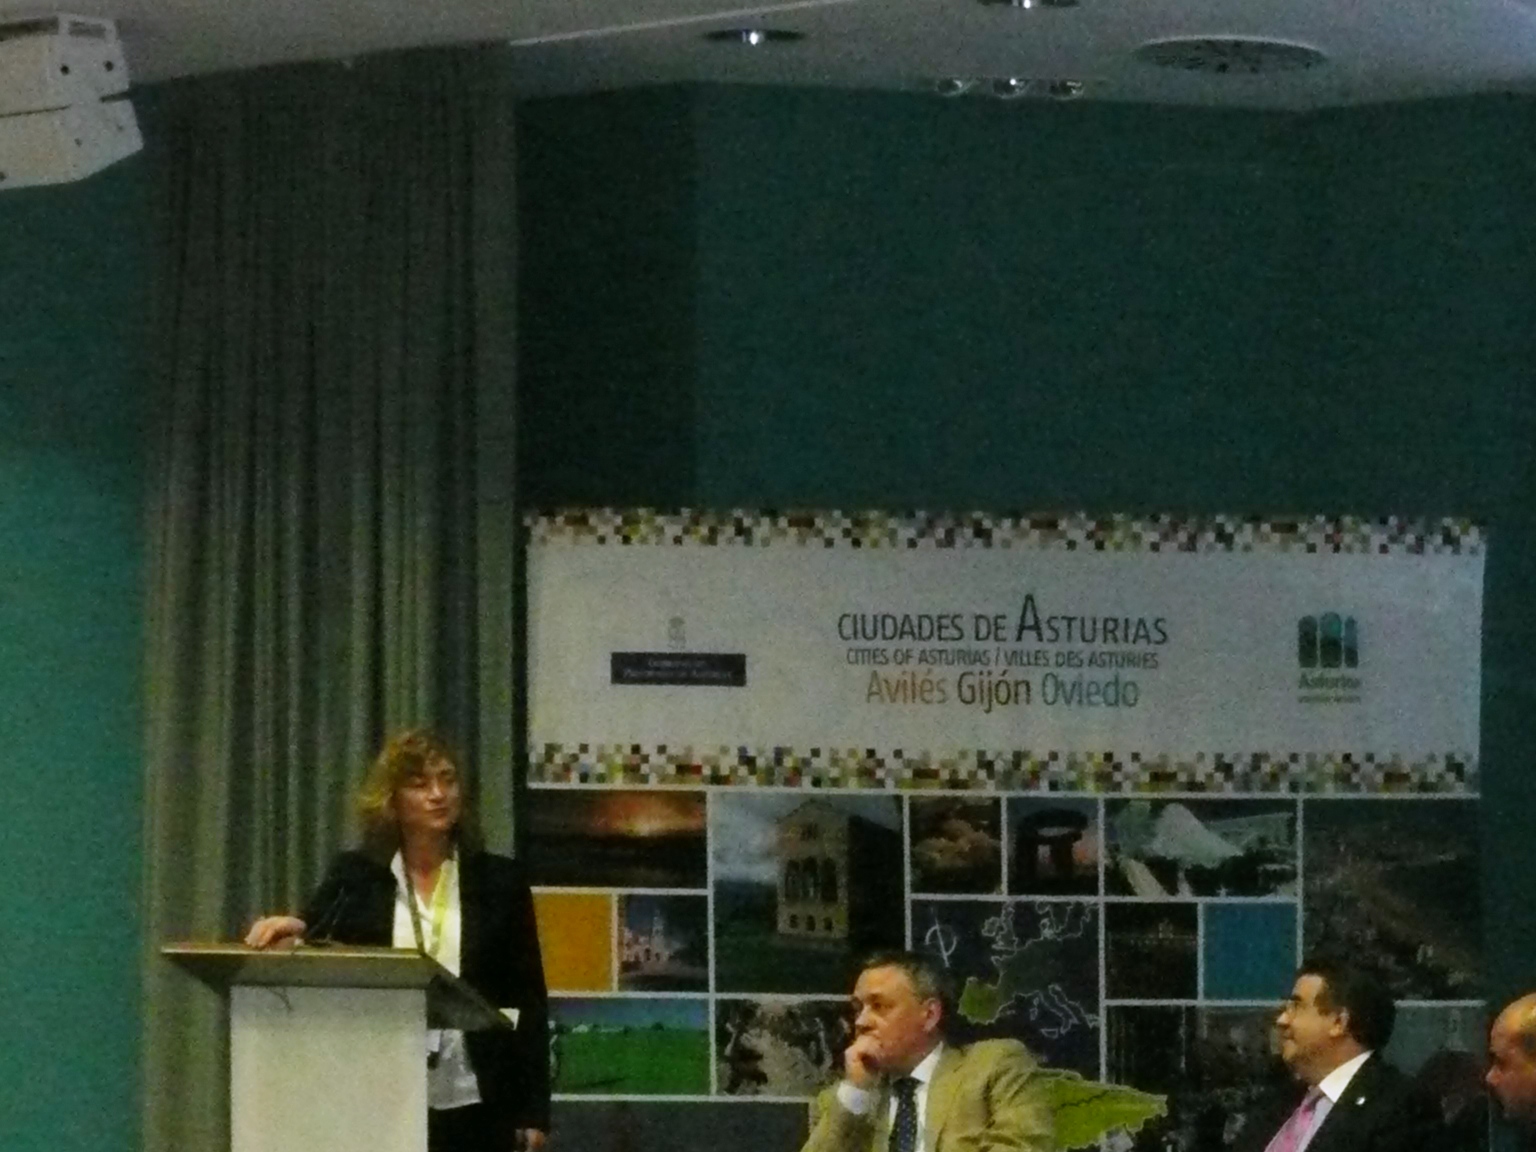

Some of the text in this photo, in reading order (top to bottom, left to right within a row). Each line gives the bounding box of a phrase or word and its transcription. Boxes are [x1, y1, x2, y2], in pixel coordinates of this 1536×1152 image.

[838, 613, 965, 642] CIUDADES
[974, 613, 1007, 642] DE
[847, 647, 889, 666] CITIES
[893, 648, 914, 666] OF
[918, 648, 991, 667] ASTURIAS
[1004, 649, 1050, 668] VILLES
[1055, 650, 1084, 669] DES
[1088, 651, 1160, 670] ASTURIES
[866, 668, 1140, 714] Avilés Gijón Oviedo
